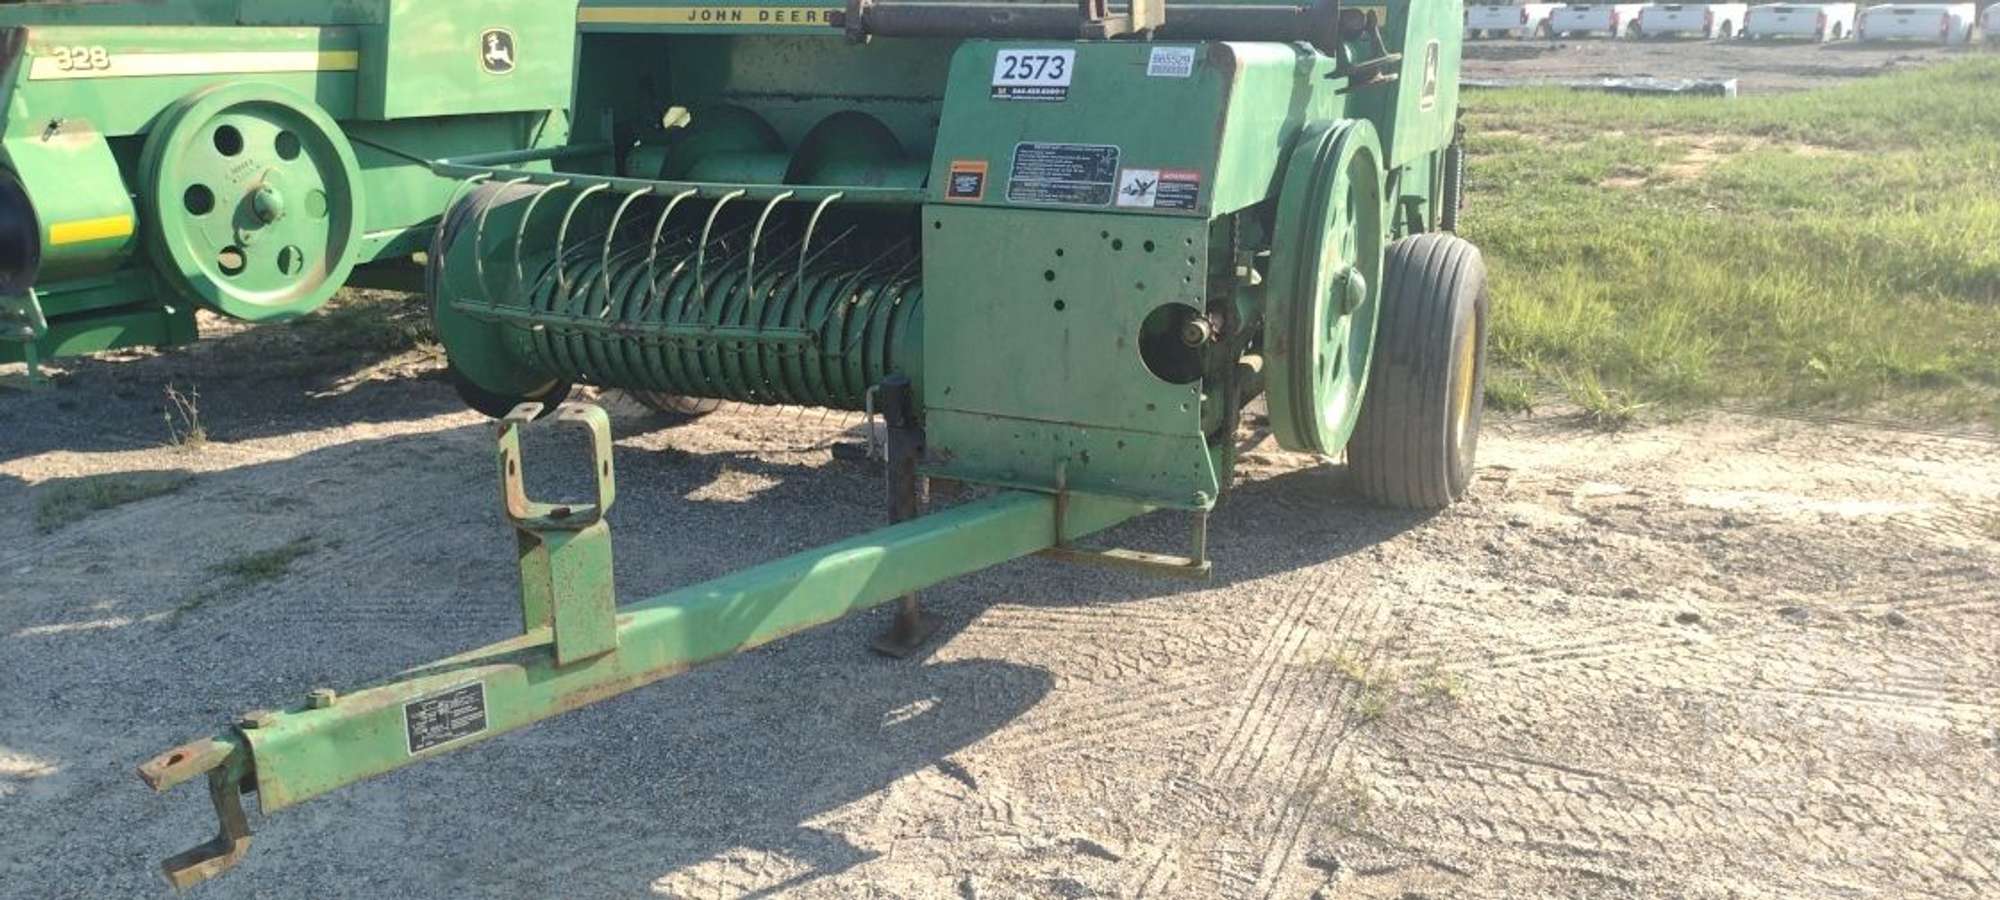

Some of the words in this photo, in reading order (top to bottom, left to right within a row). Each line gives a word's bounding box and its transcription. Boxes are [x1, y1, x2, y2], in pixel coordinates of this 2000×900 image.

[688, 10, 741, 21] JOHN
[759, 10, 832, 22] DEERE
[54, 45, 111, 71] 328
[1001, 55, 1066, 79] 2573
